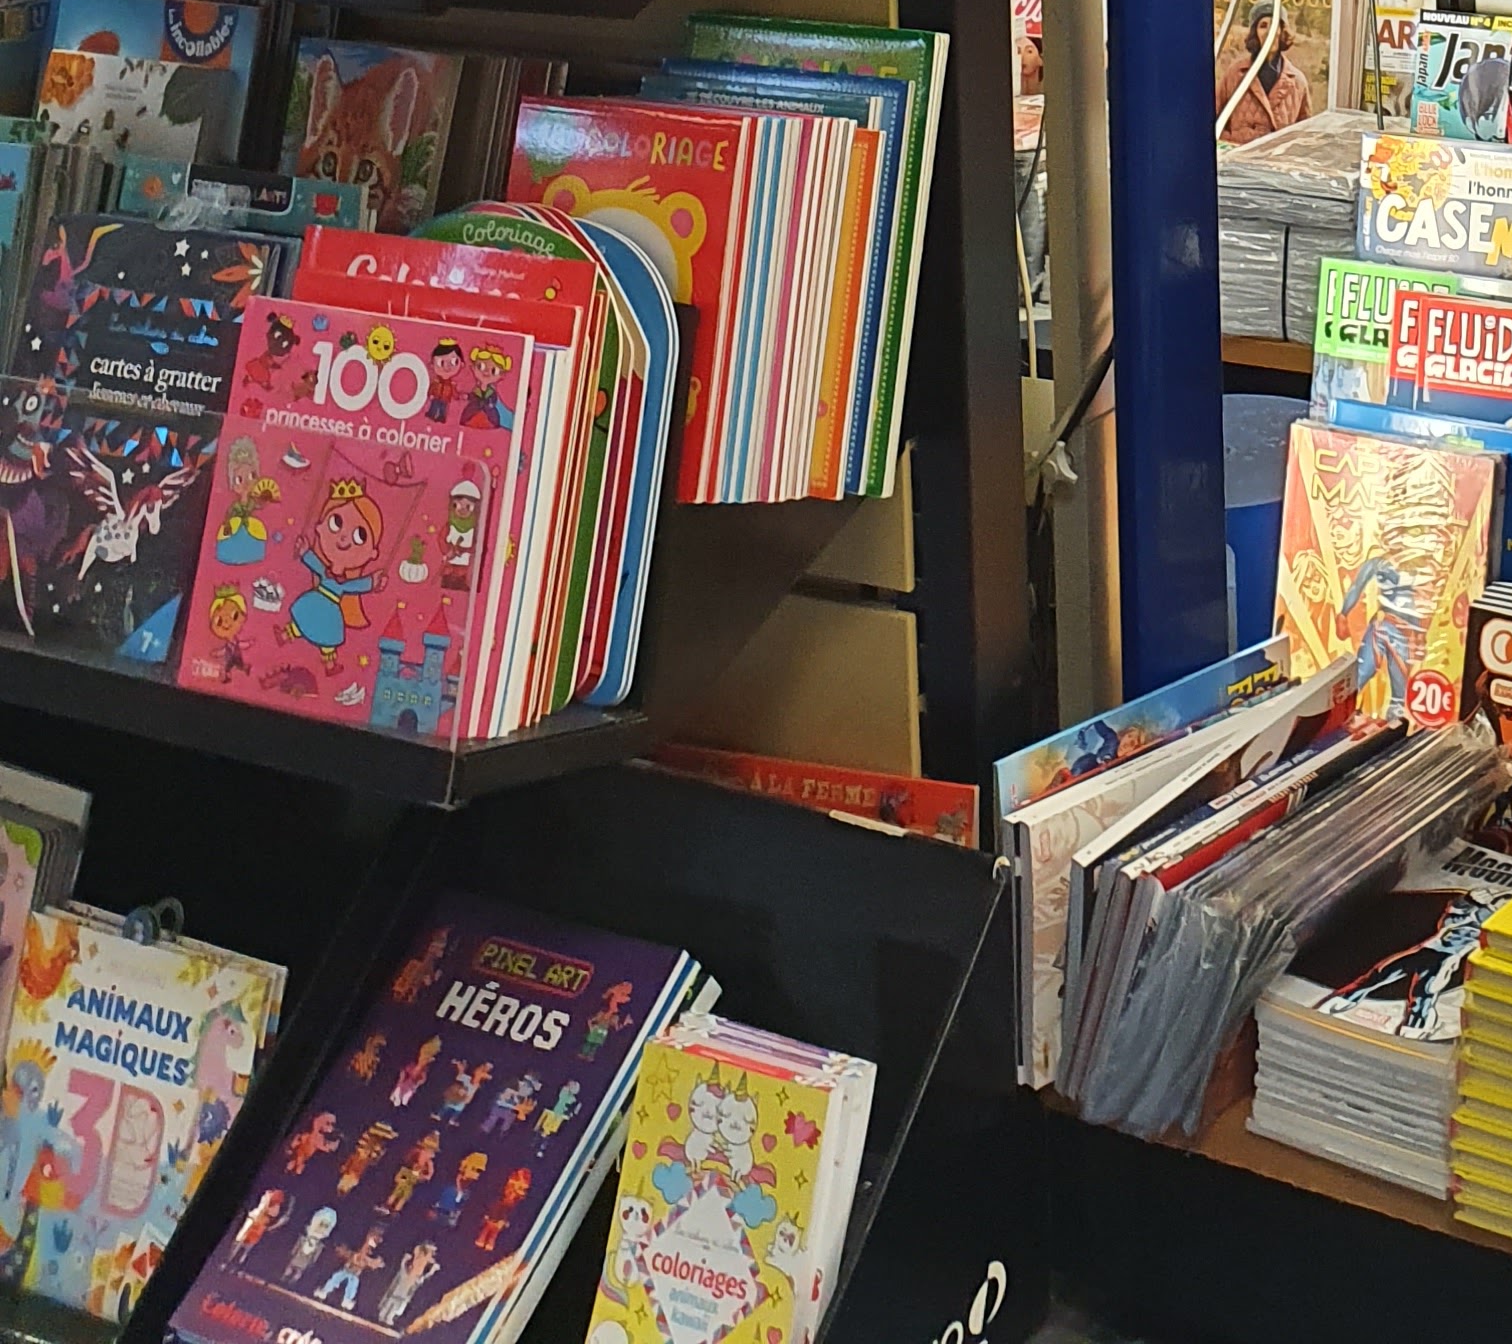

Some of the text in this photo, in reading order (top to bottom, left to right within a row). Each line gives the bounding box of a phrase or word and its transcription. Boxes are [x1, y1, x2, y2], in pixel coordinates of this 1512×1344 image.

[1422, 11, 1470, 26] NOUVEAU
[90, 355, 222, 396] cartes à gratter
[312, 342, 430, 420] 100
[263, 407, 354, 440] princesses
[358, 414, 373, 437] à
[376, 422, 451, 454] colorier
[1410, 677, 1454, 715] 20€
[67, 985, 193, 1043] ANIMAUX
[436, 980, 570, 1051] HÉROS
[55, 1021, 191, 1086] MAGIQUES
[63, 1068, 164, 1215] 3D
[652, 1250, 748, 1300] coloriages
